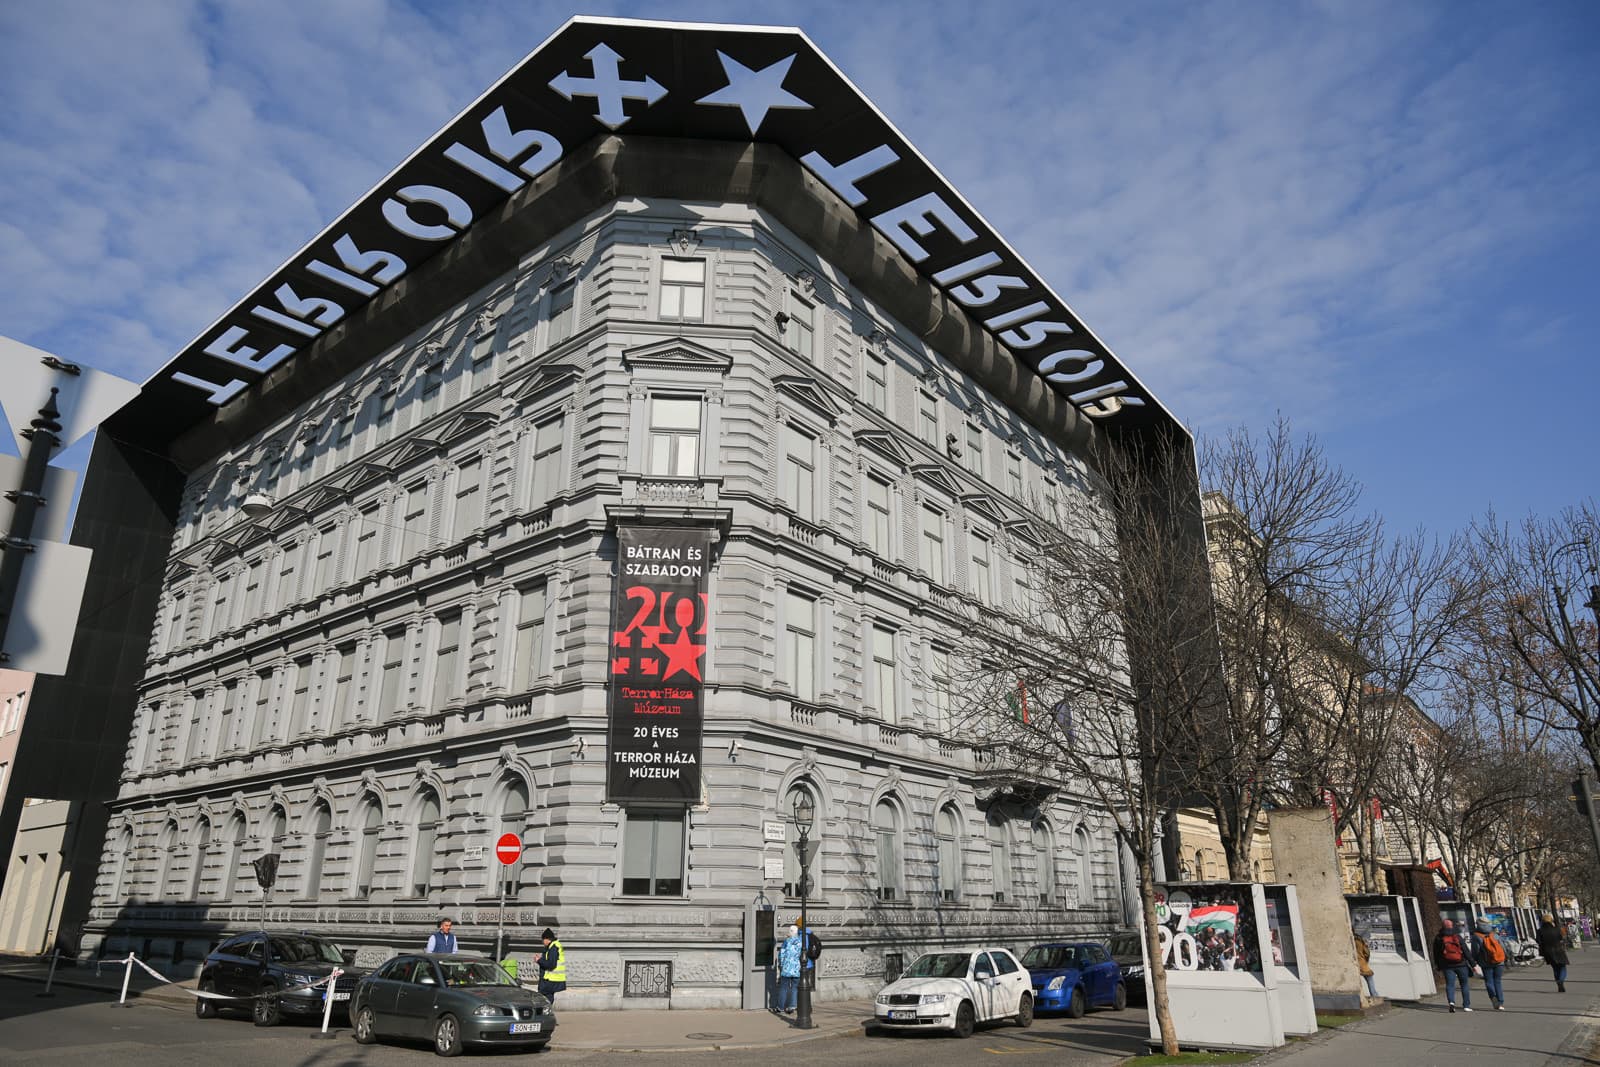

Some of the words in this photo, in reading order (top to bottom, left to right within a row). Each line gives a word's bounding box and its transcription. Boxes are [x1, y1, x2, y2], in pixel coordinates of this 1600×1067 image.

[627, 544, 681, 560] BÁTRAN
[687, 546, 702, 560] ÉS
[625, 563, 702, 577] SZABADON
[633, 700, 682, 714] Múzeum
[633, 727, 648, 738] 20
[651, 725, 679, 738] ÉVES
[614, 752, 661, 763] TERROR
[664, 750, 696, 764] HÁZA
[629, 765, 680, 779] MÚZEUM
